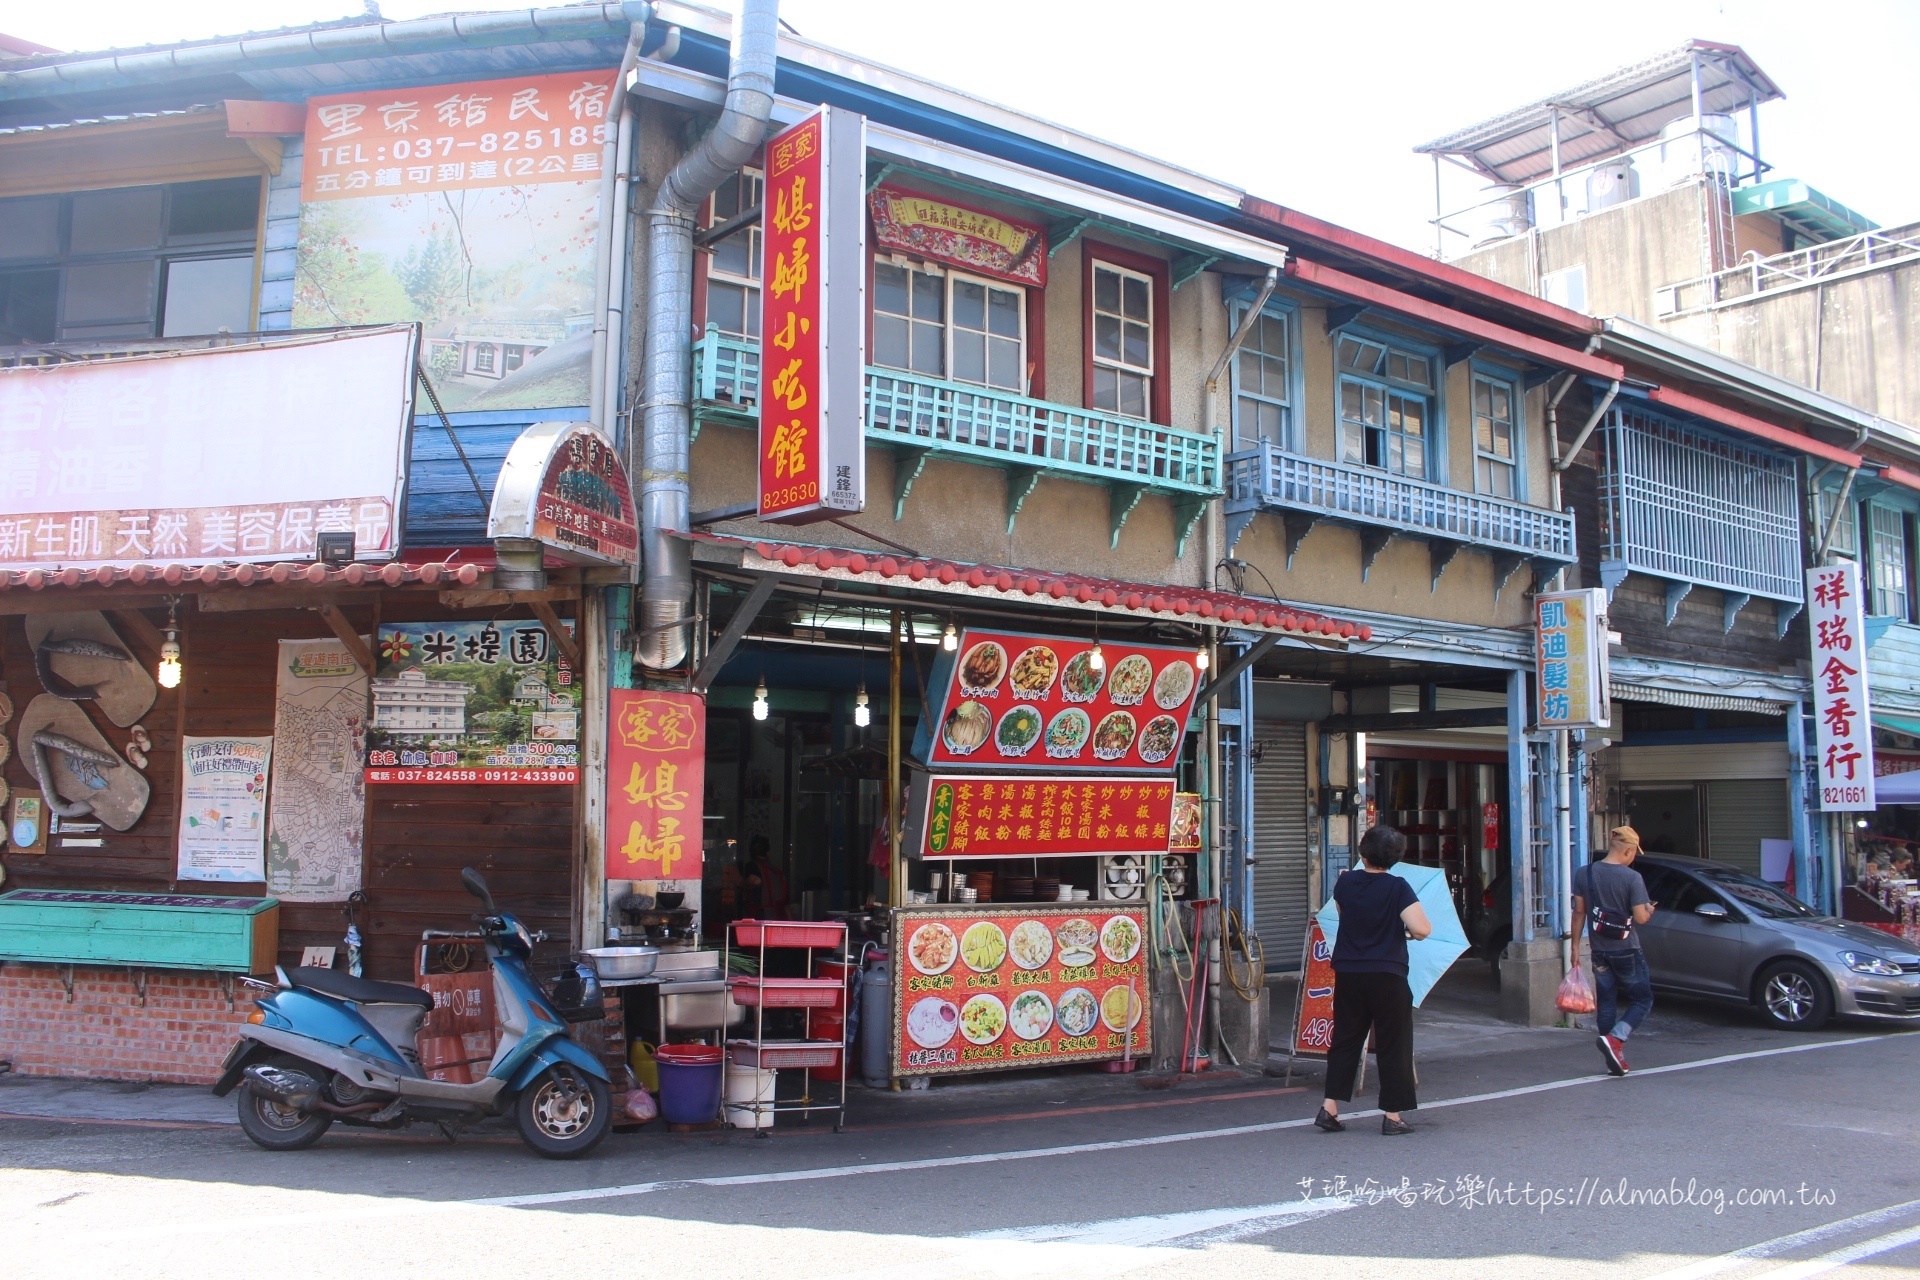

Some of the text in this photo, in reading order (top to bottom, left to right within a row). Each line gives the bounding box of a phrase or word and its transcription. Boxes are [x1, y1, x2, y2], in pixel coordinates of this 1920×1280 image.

[316, 152, 603, 192] 五分鐘可到達(2公里
[776, 133, 812, 168] 客家
[768, 176, 813, 478] 媳婦小吃館
[763, 481, 817, 508] 823630
[831, 490, 856, 500] 665372
[0, 503, 391, 558] 新生肌 天然 美容保養品
[1540, 601, 1569, 719] 凱迪髮坊
[1814, 570, 1862, 781] 祥瑞金香行
[190, 742, 266, 759] 行動支付免現金
[627, 706, 687, 745] 客家
[620, 759, 689, 876] 媳婦
[932, 786, 952, 850] 素食可
[951, 783, 974, 852] 客家豬腳
[974, 783, 995, 841] 魯肉飯
[995, 783, 1016, 840] 湯米粉
[1057, 785, 1077, 840] 水餃10粒
[1078, 784, 1096, 840] 客家湯圓
[1095, 785, 1115, 839] 炒米粉
[1115, 785, 1133, 838] 炒飯
[1151, 785, 1170, 839] 炒麵
[1824, 786, 1866, 804] 821661
[433, 989, 481, 1009] 請勿 停車
[909, 975, 954, 991] 客家豬腳
[967, 973, 1000, 987] 白斬雞
[1011, 970, 1051, 986] 薑絲大腸
[1011, 1041, 1051, 1056] 客家湯圓
